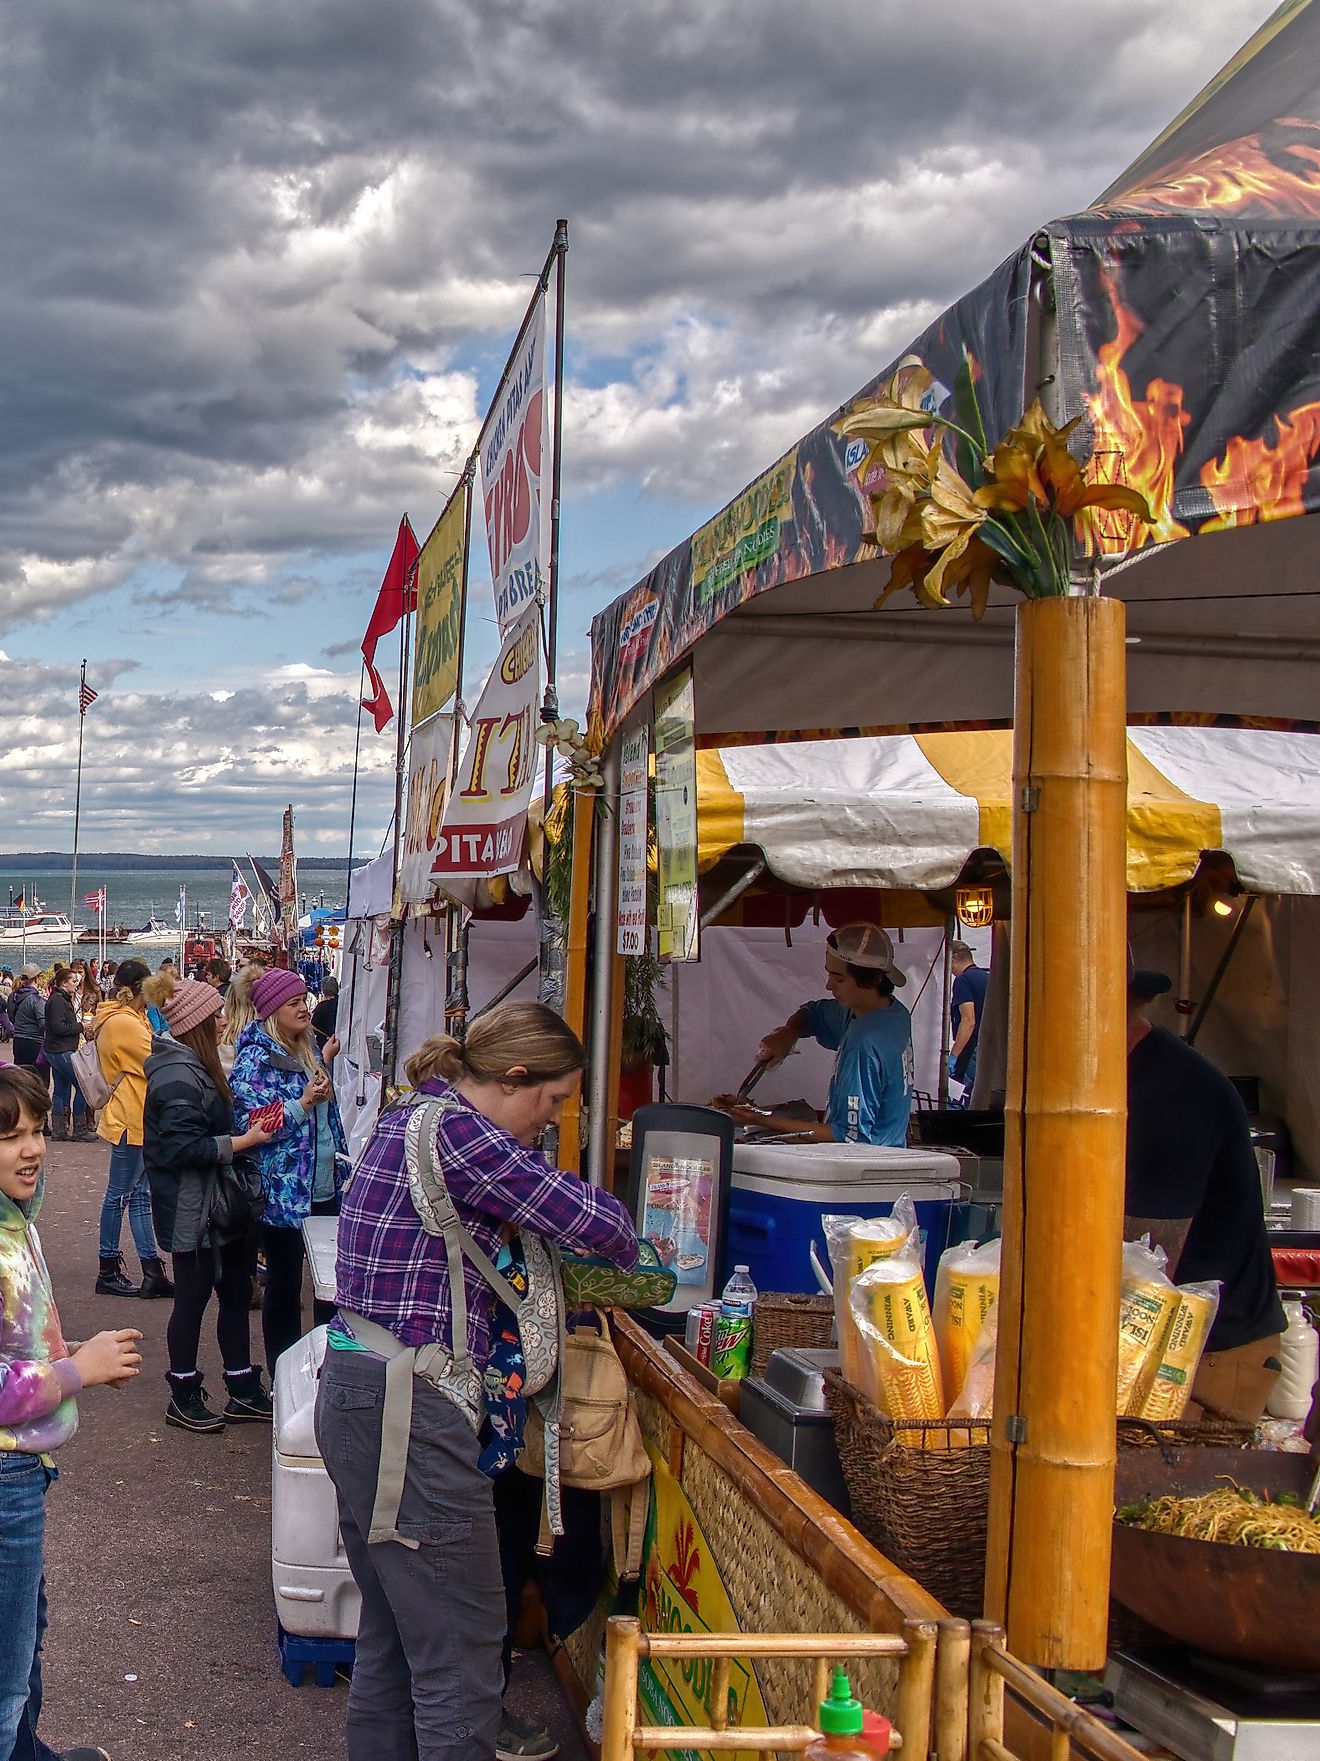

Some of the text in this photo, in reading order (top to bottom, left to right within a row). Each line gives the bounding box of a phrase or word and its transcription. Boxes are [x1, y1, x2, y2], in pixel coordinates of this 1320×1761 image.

[623, 929, 640, 951] $7.00
[699, 1317, 713, 1346] Coke
[883, 1294, 895, 1341] WINNING
[903, 1297, 916, 1332] AWARD
[1168, 1304, 1189, 1351] WINNING
[1179, 1311, 1194, 1348] AWARD
